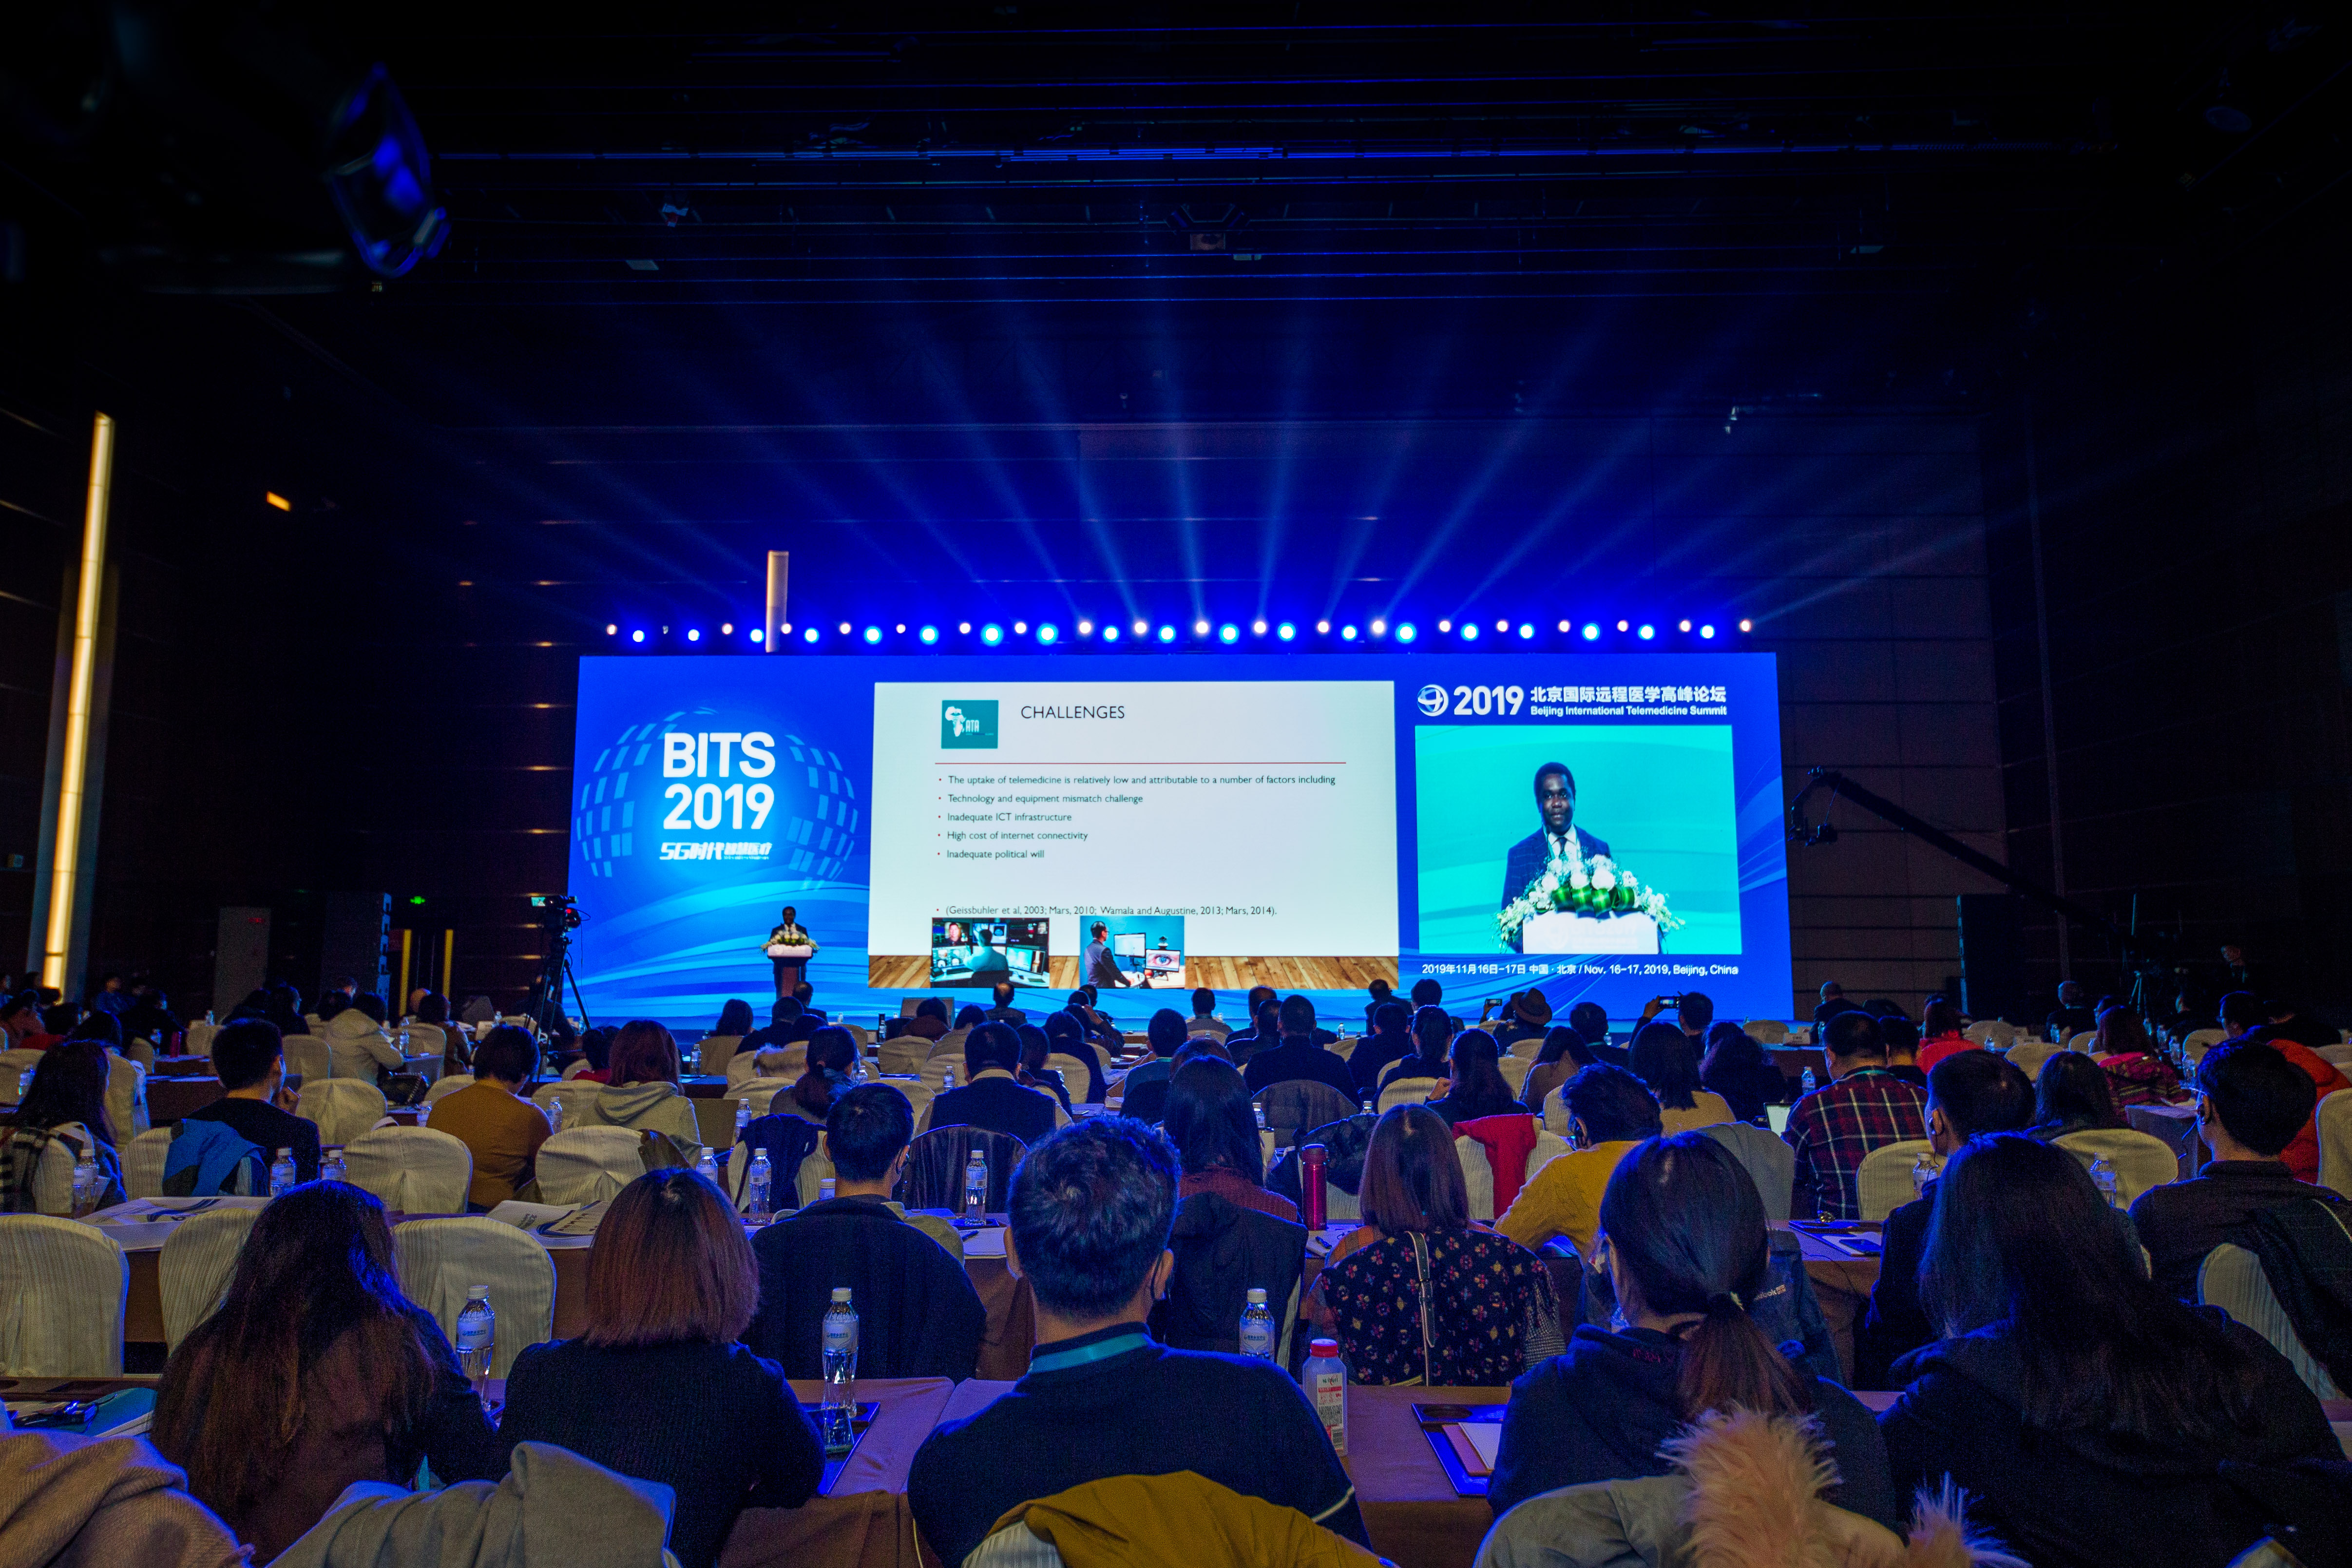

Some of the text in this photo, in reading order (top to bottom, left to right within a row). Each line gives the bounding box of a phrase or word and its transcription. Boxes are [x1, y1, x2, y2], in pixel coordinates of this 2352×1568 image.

[1453, 685, 1524, 715] 2019
[1530, 686, 1727, 703] 北京国际远程医学高峰论坛
[1021, 706, 1125, 719] CHALLENGES
[1530, 705, 1727, 717] Beijing International Telemedicine Summit
[965, 719, 980, 732] ATA
[663, 731, 776, 778] BITS
[948, 775, 964, 784] The
[967, 776, 995, 785] uptake
[1065, 776, 1071, 784] is
[1073, 776, 1110, 786] relatively
[1131, 776, 1147, 784] and
[1220, 775, 1252, 784] number
[1255, 775, 1264, 784] of
[1266, 775, 1296, 784] factors
[1299, 775, 1336, 786] including
[948, 794, 1143, 805] Technology and equipment mismatch challenge
[663, 783, 775, 830] 2019
[948, 812, 1072, 823] Inadequate ICT infrastructure
[947, 831, 966, 841] High
[990, 831, 998, 839] of
[1037, 831, 1088, 841] connectivity
[947, 850, 1044, 860] Inadequate political will
[946, 906, 999, 915] (Geissbuhler
[1013, 906, 1022, 915] al,
[1024, 906, 1047, 915] 2003;
[1049, 906, 1071, 915] Mars,
[1074, 906, 1098, 915] 2010;
[1100, 906, 1134, 915] Wamala
[1137, 906, 1152, 915] and
[1154, 906, 1198, 917] Augustine,
[1200, 906, 1224, 915] 2013;
[1226, 906, 1248, 916] Mars,
[1250, 906, 1277, 915] 2014).
[1529, 964, 1549, 975] 中国
[1556, 964, 1576, 975] 北京
[1584, 964, 1607, 975] Nov.
[1644, 964, 1671, 975] 2019,
[1673, 964, 1708, 976] Beijing,
[1710, 964, 1739, 975] China
